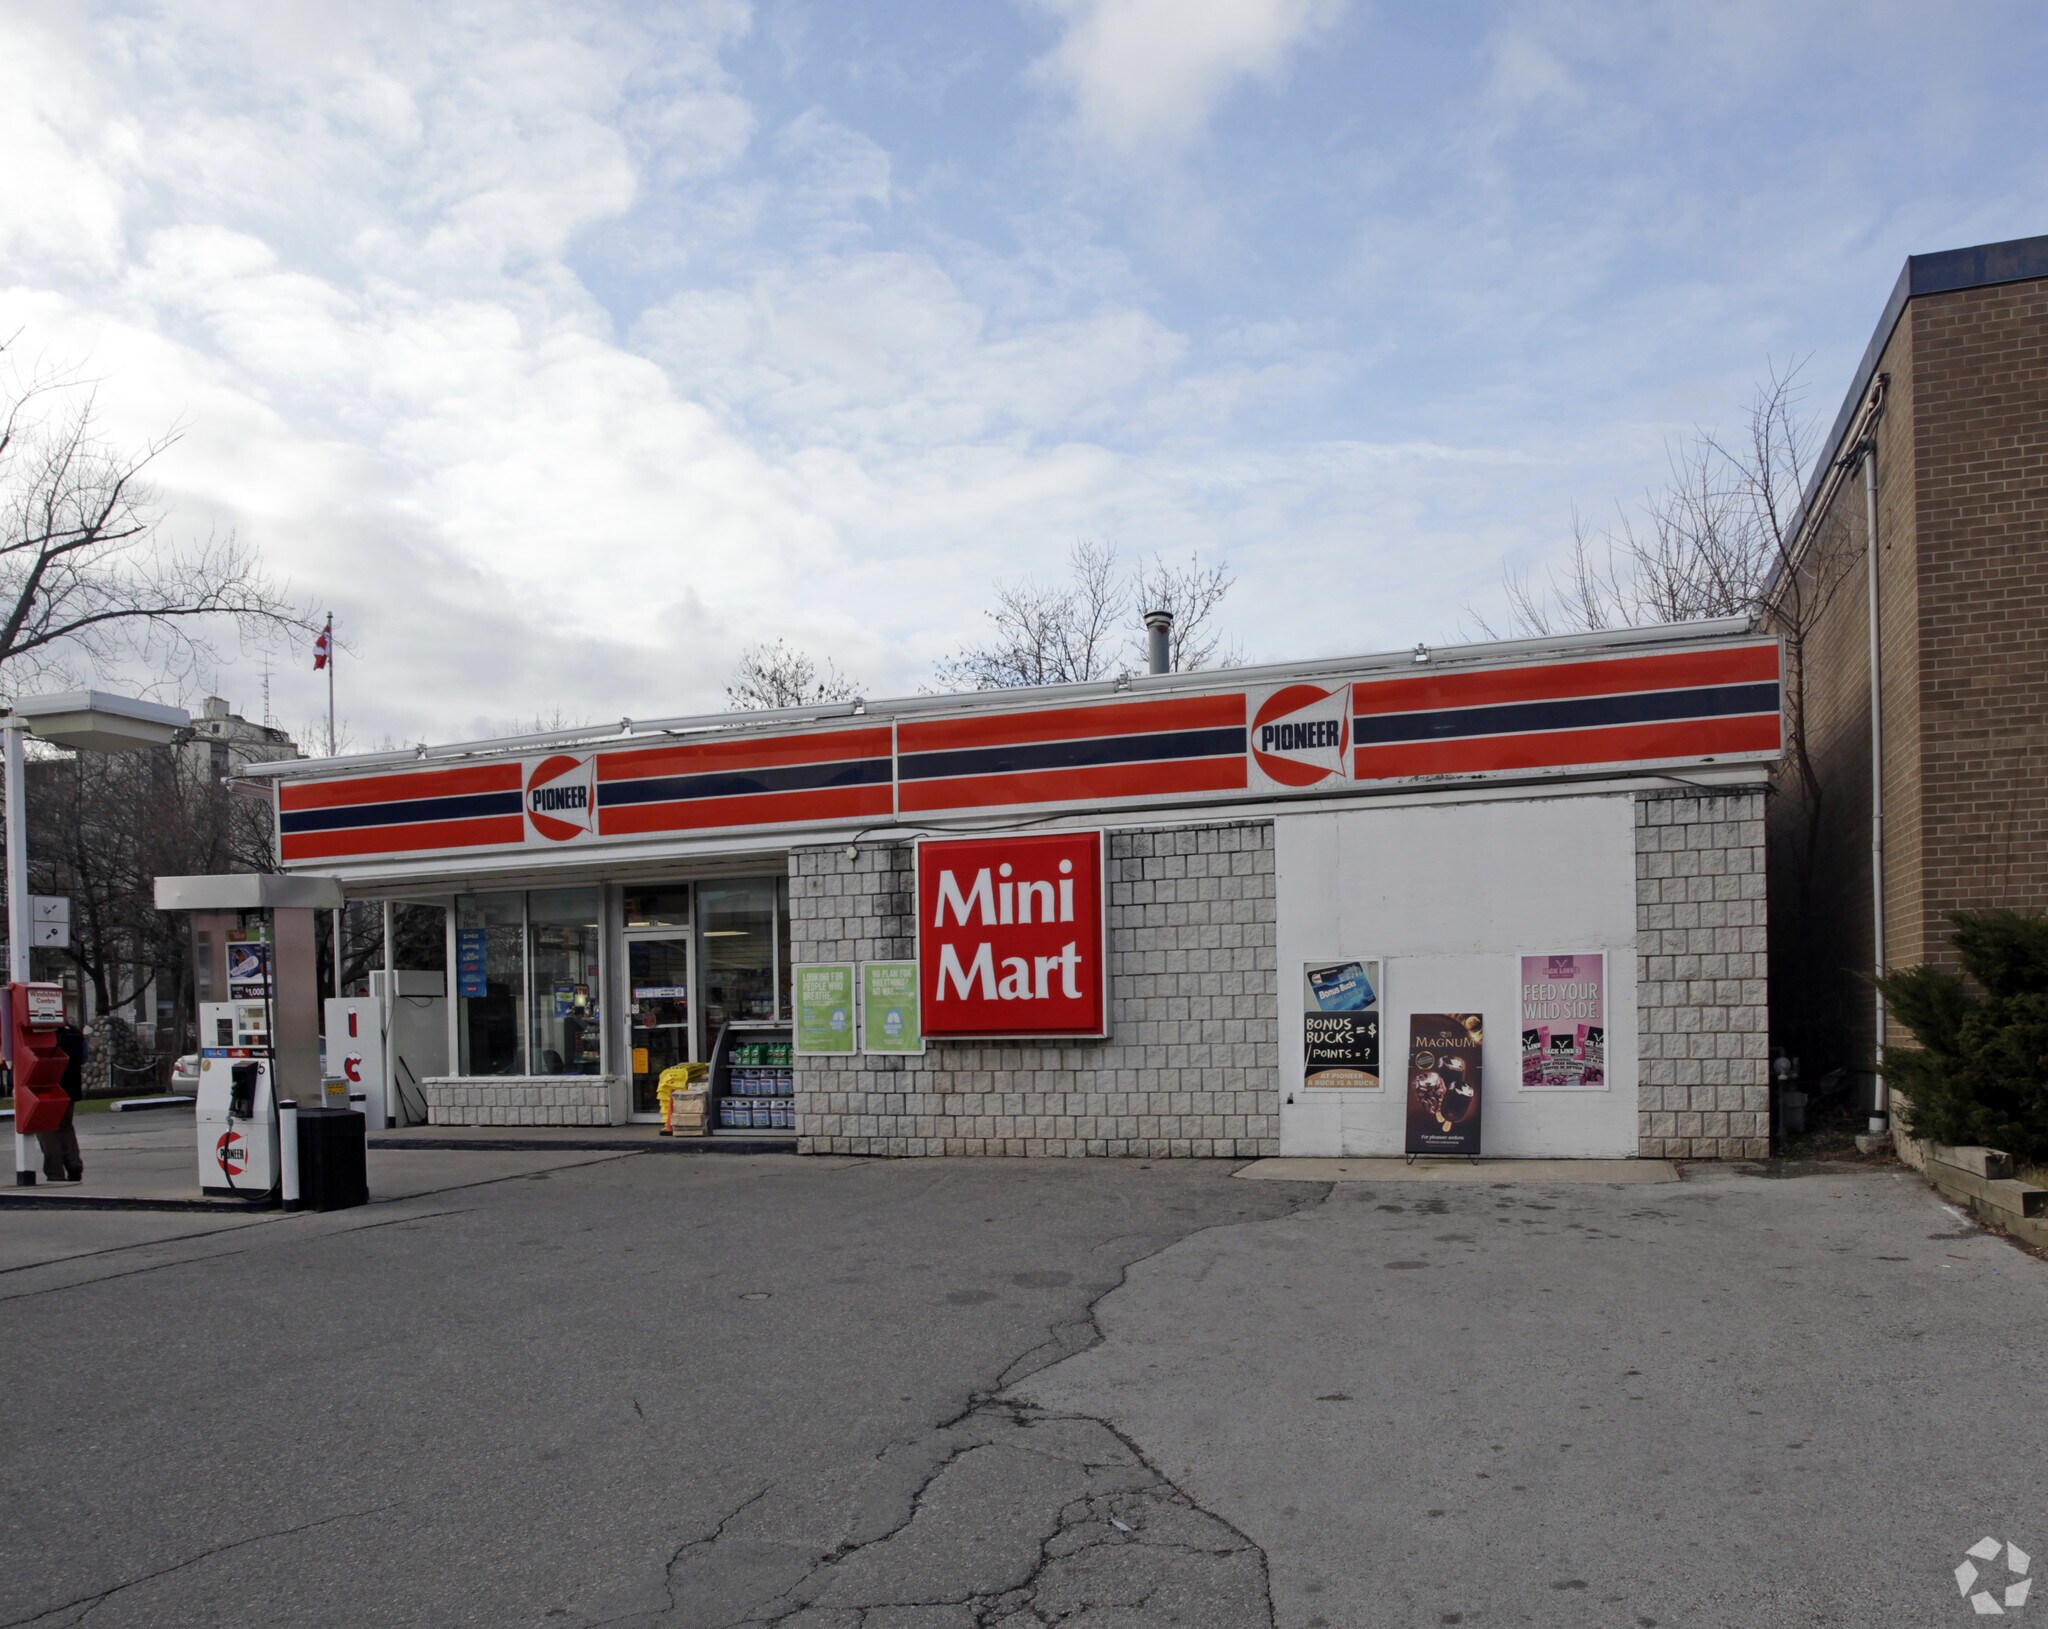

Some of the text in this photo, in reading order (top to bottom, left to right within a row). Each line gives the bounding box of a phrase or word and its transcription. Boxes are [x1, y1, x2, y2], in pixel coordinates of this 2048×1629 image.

[1262, 720, 1339, 752] PIONEER
[532, 785, 587, 812] PIONEER
[934, 858, 1075, 928] Mini
[802, 971, 844, 982] LOOKING FOR
[872, 968, 912, 978] NO PLAN FOR
[935, 941, 1083, 1001] Mart
[245, 986, 265, 998] $1,000
[802, 981, 843, 991] PEOPLE WHO
[872, 987, 881, 996] NO
[1318, 986, 1341, 1000] Bonus
[1339, 980, 1357, 993] Bucks
[1523, 982, 1599, 1001] FEED YOUR
[1523, 1001, 1600, 1020] WILD SIDE.
[1306, 1018, 1352, 1031] BONUS
[1367, 1022, 1377, 1038] $
[1306, 1031, 1355, 1044] BUCKS
[1415, 1036, 1476, 1048] MAGNUM
[1313, 1049, 1352, 1058] POINTS
[258, 1061, 266, 1075] 5
[220, 1148, 244, 1160] PONEER
